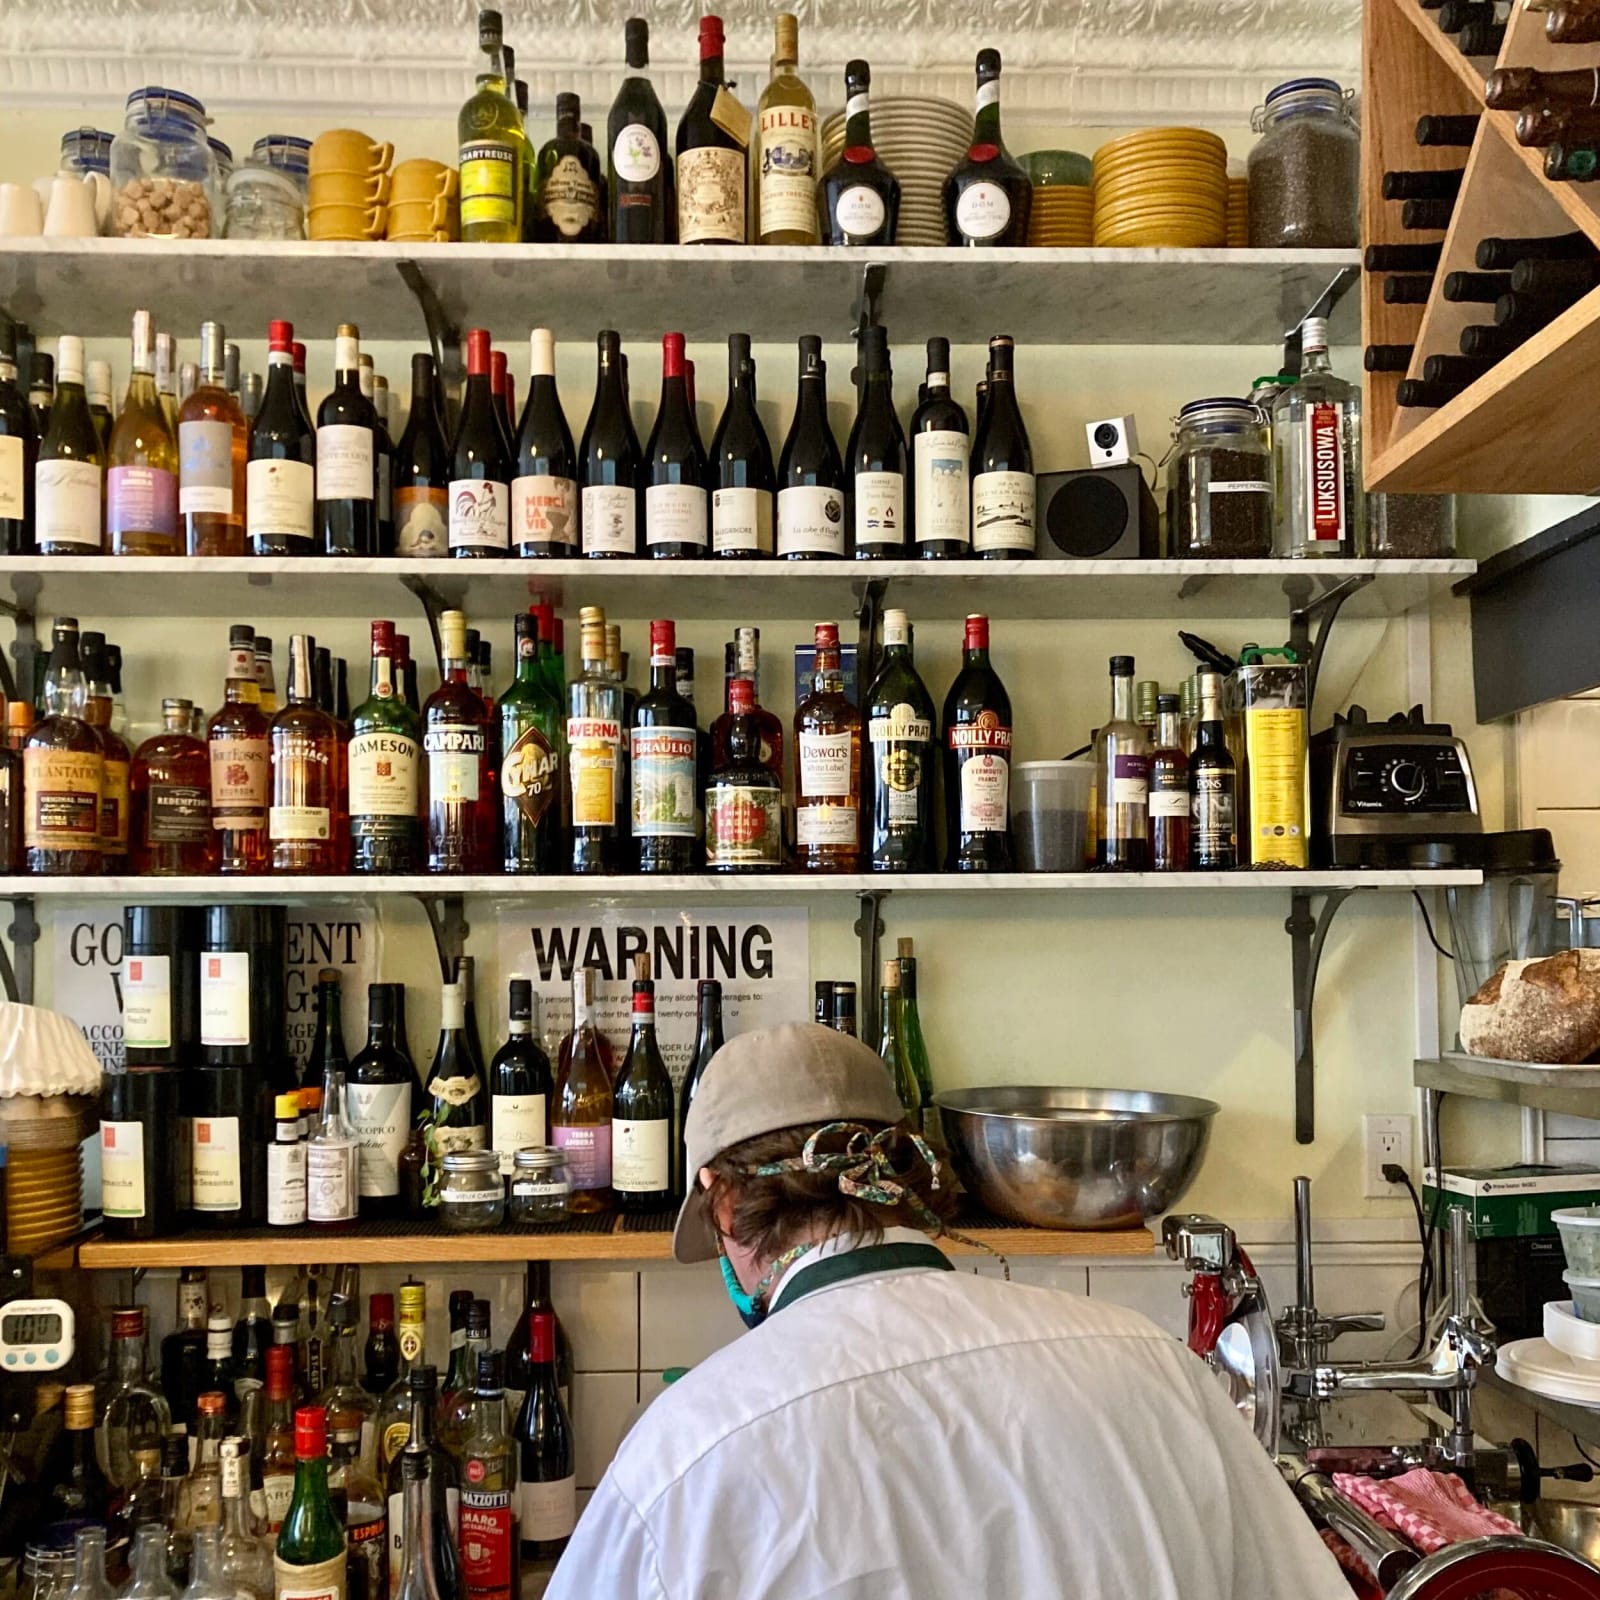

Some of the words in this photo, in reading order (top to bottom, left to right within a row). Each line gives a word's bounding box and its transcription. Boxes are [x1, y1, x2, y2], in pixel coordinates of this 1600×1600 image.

[761, 111, 817, 131] LILLET
[1316, 426, 1336, 520] LUKSUSOWA
[526, 508, 541, 517] LA
[526, 519, 547, 529] VIE
[568, 723, 619, 738] AVERNA
[908, 724, 930, 737] PRAT
[952, 728, 993, 744] NOILLY
[352, 739, 415, 758] JAMESON
[423, 732, 485, 751] CAMPARI
[636, 740, 692, 754] BRAULIO
[803, 745, 848, 759] Dewar's
[527, 783, 542, 797] 70
[1196, 779, 1222, 789] PONS
[531, 924, 773, 983] WARNING
[462, 1492, 508, 1506] MAZZOTTI
